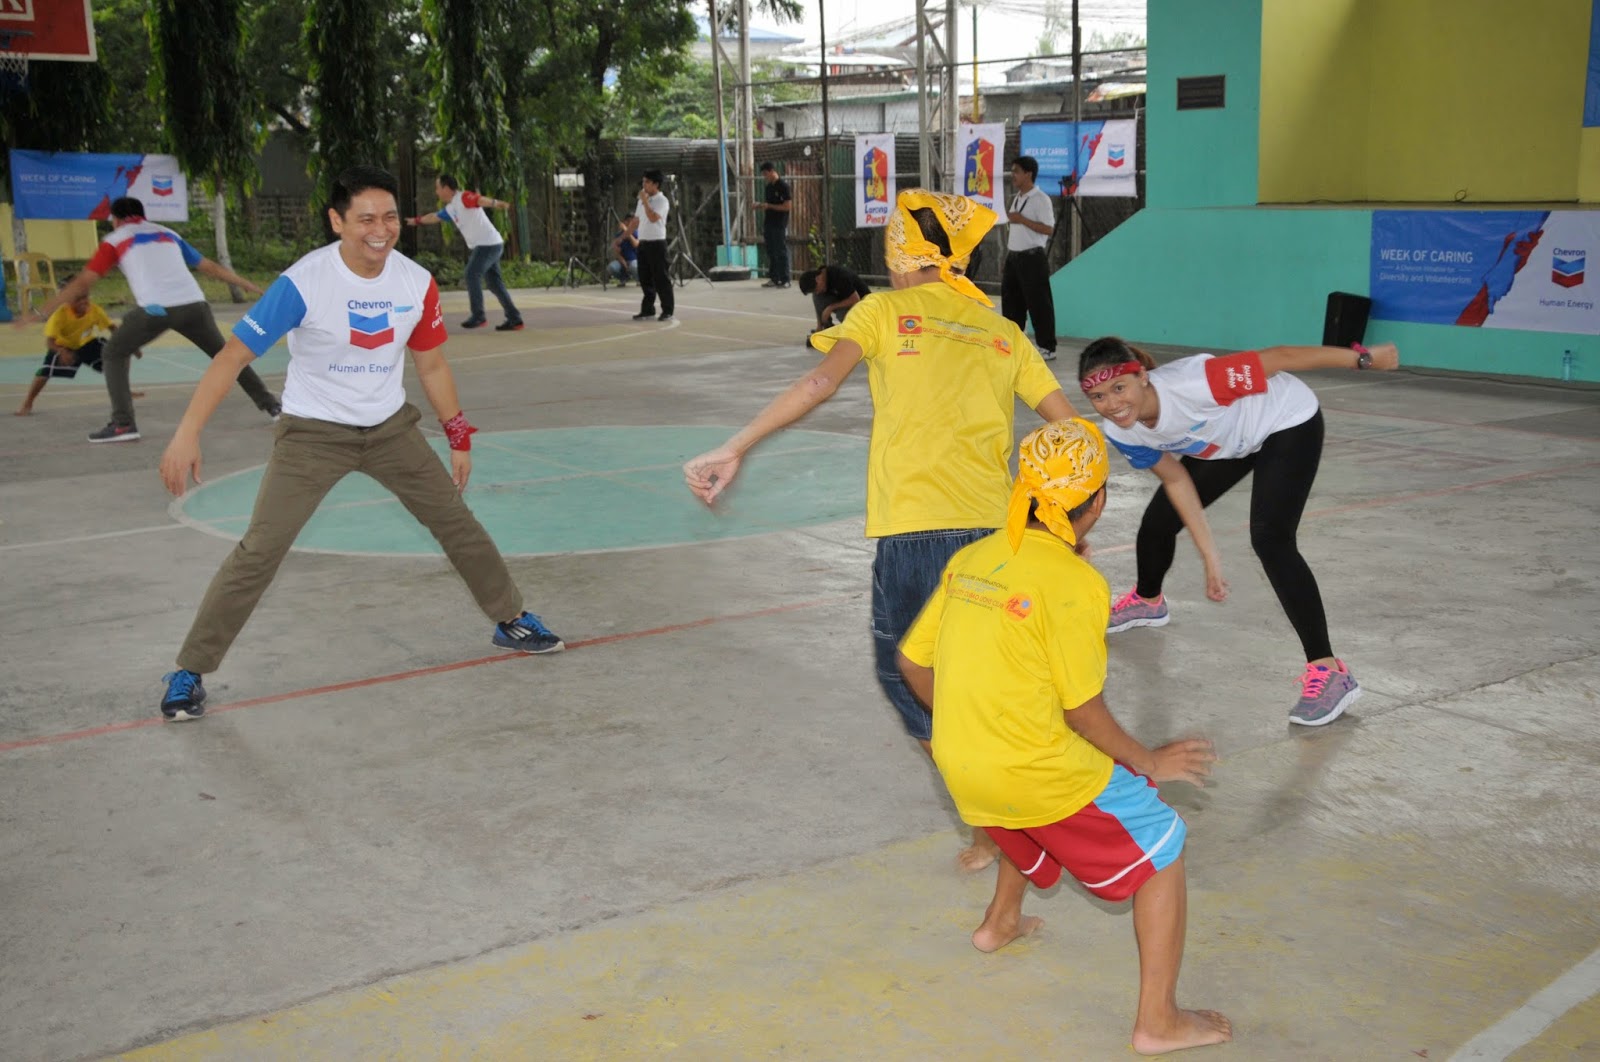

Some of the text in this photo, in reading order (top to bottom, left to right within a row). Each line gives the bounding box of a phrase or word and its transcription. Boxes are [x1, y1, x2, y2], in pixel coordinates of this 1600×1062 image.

[20, 174, 97, 183] WEEK OF CARING
[1380, 248, 1474, 264] WEEK OF CARING
[1552, 247, 1586, 256] Chevron
[1380, 272, 1473, 284] Diversity and Volunteerism
[347, 299, 393, 310] Chevron
[1539, 298, 1594, 310] Human Energy
[902, 339, 915, 349] 41
[328, 363, 394, 373] Human Ener
[1225, 366, 1237, 389] Week
[1235, 373, 1244, 382] of
[1241, 364, 1253, 390] Caring
[1159, 436, 1192, 449] Chevro
